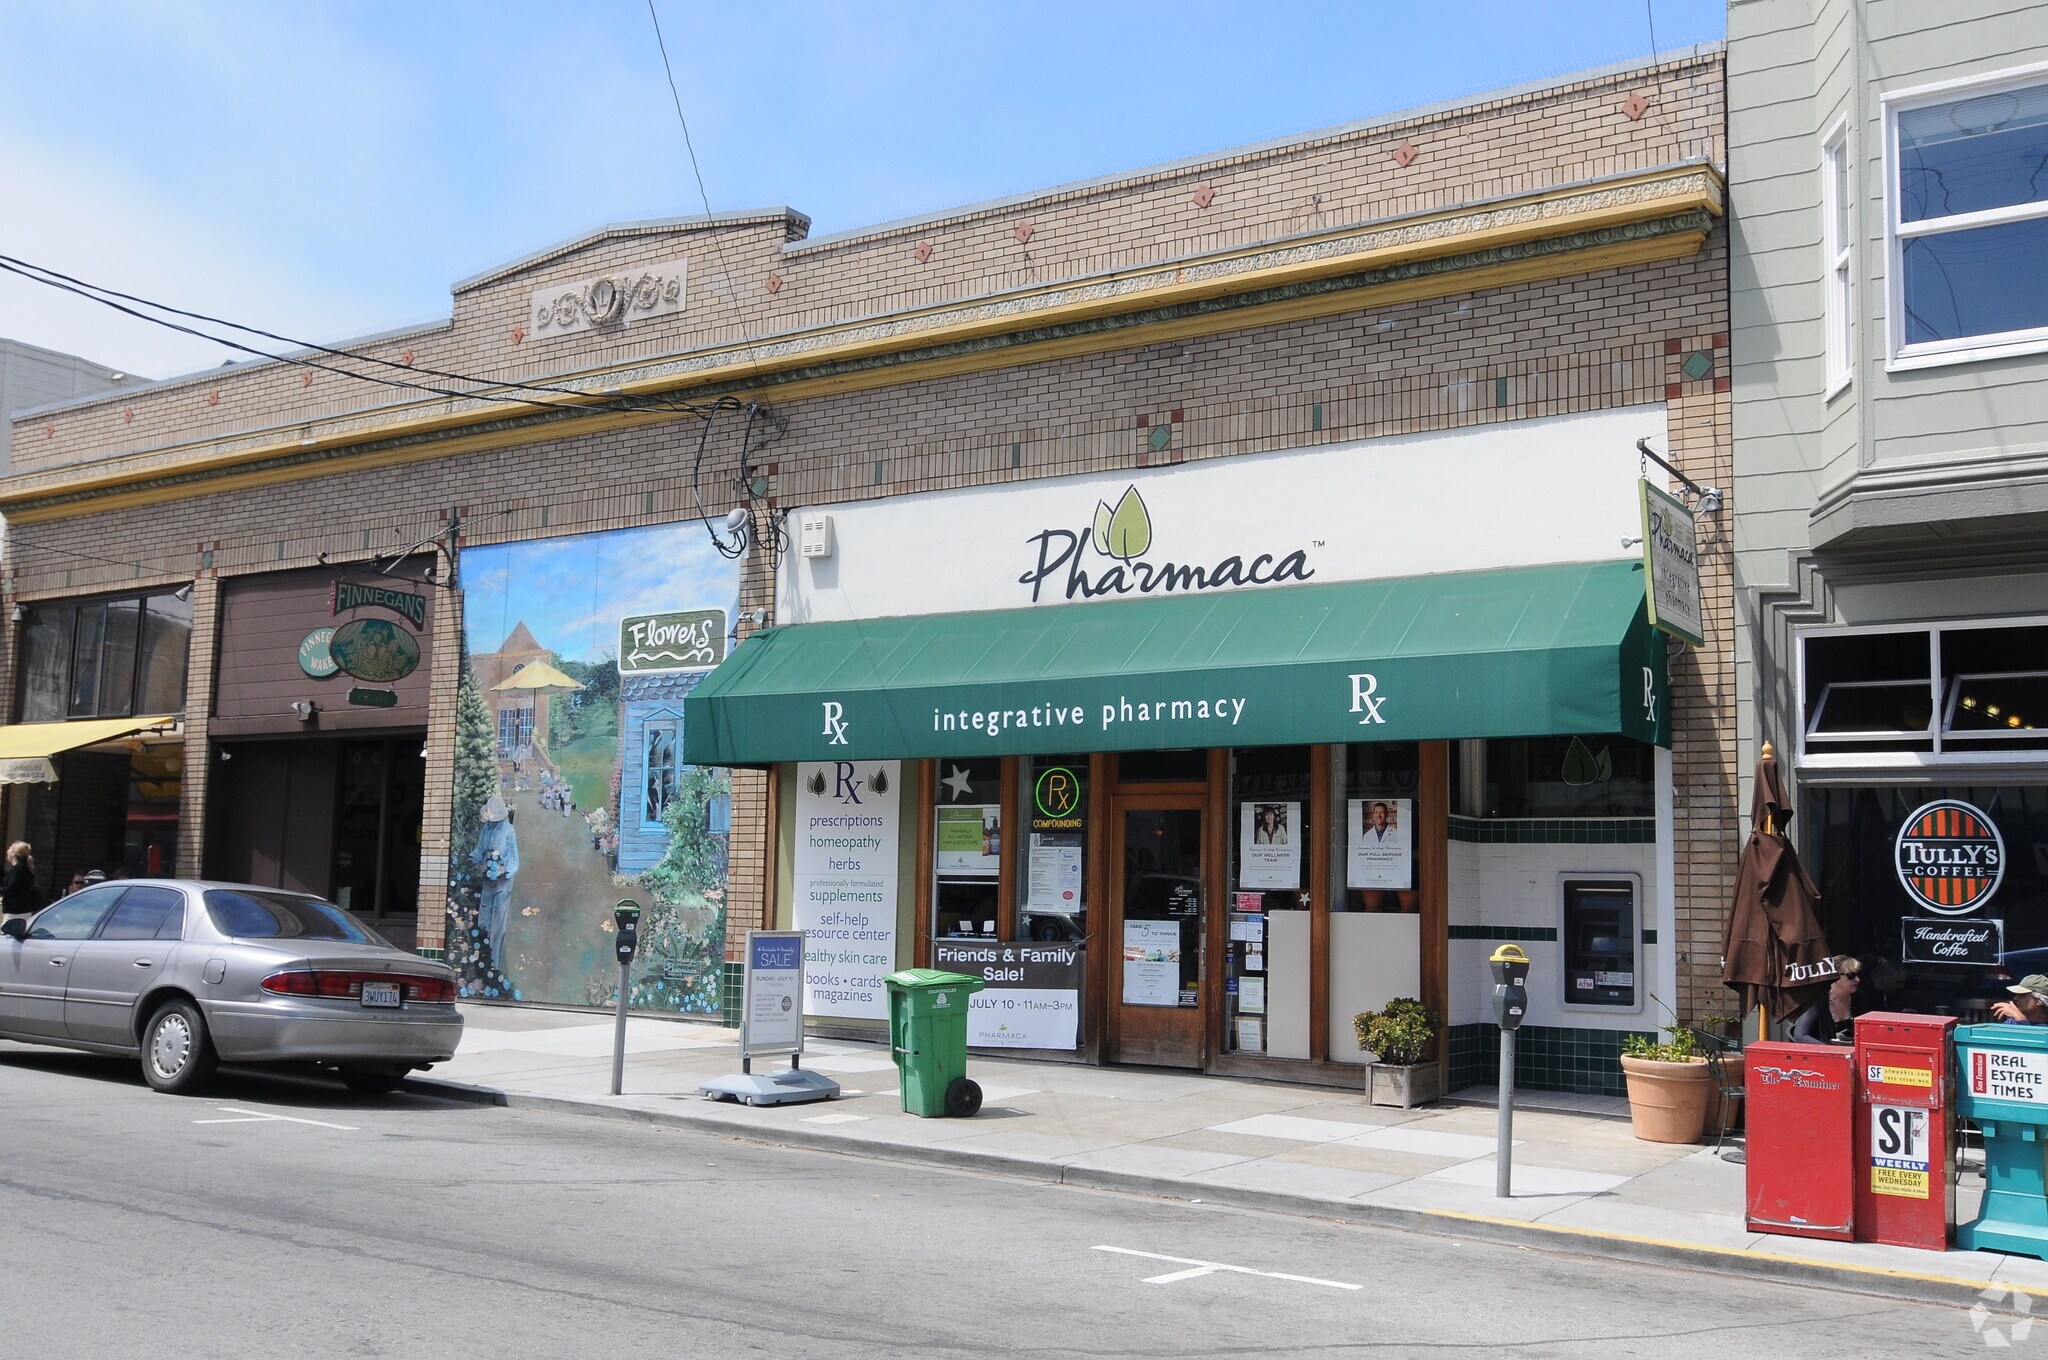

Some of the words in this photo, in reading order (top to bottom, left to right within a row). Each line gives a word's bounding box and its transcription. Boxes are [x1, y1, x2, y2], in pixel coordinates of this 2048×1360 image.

[1652, 511, 1695, 566] Pharmaca
[1018, 527, 1316, 603] Pharmaca
[336, 583, 425, 625] FINNEGANS
[310, 656, 333, 671] WAKE
[933, 702, 1085, 736] integrative
[1102, 696, 1247, 730] pharmacy
[810, 814, 883, 830] prescriptions
[1033, 819, 1081, 828] COMPOUNDING
[809, 834, 882, 852] homeopathy
[1902, 842, 1998, 865] TULLY'S
[829, 857, 861, 870] herbs
[1914, 866, 1986, 877] COFFEE
[810, 879, 849, 888] professionally
[850, 880, 884, 888] formulated
[809, 888, 883, 905] supplements
[820, 912, 869, 929] self-help
[852, 929, 891, 941] center
[1141, 924, 1151, 937] 5
[1913, 926, 1989, 942] Handcrafted
[938, 948, 997, 963] Friends
[1002, 949, 1015, 963] &
[1020, 948, 1076, 965] Family
[1932, 942, 1969, 956] Coffee
[760, 952, 792, 967] SALE
[803, 948, 837, 966] ealthy
[838, 950, 860, 964] skin
[863, 954, 888, 965] care
[805, 971, 840, 986] books
[850, 974, 882, 988] cards
[983, 967, 1025, 982] Sale!
[365, 990, 398, 1005] 3WUY174
[813, 988, 873, 1003] magazines
[970, 998, 998, 1009] JULY
[1001, 999, 1015, 1010] 10
[979, 1031, 1027, 1040] PHARMACA
[1991, 1054, 2027, 1068] REAL
[1870, 1066, 1882, 1079] SF
[1991, 1069, 2042, 1085] ESTATE
[1760, 1073, 1780, 1085] The
[1792, 1075, 1840, 1090] Examiner
[1976, 1081, 1984, 1091] San
[1991, 1084, 2034, 1099] TIMES
[1875, 1158, 1926, 1171] WEEKLY
[1878, 1169, 1897, 1178] FREE
[1899, 1171, 1922, 1180] EVERY
[1878, 1176, 1922, 1187] WEDNESDAY
